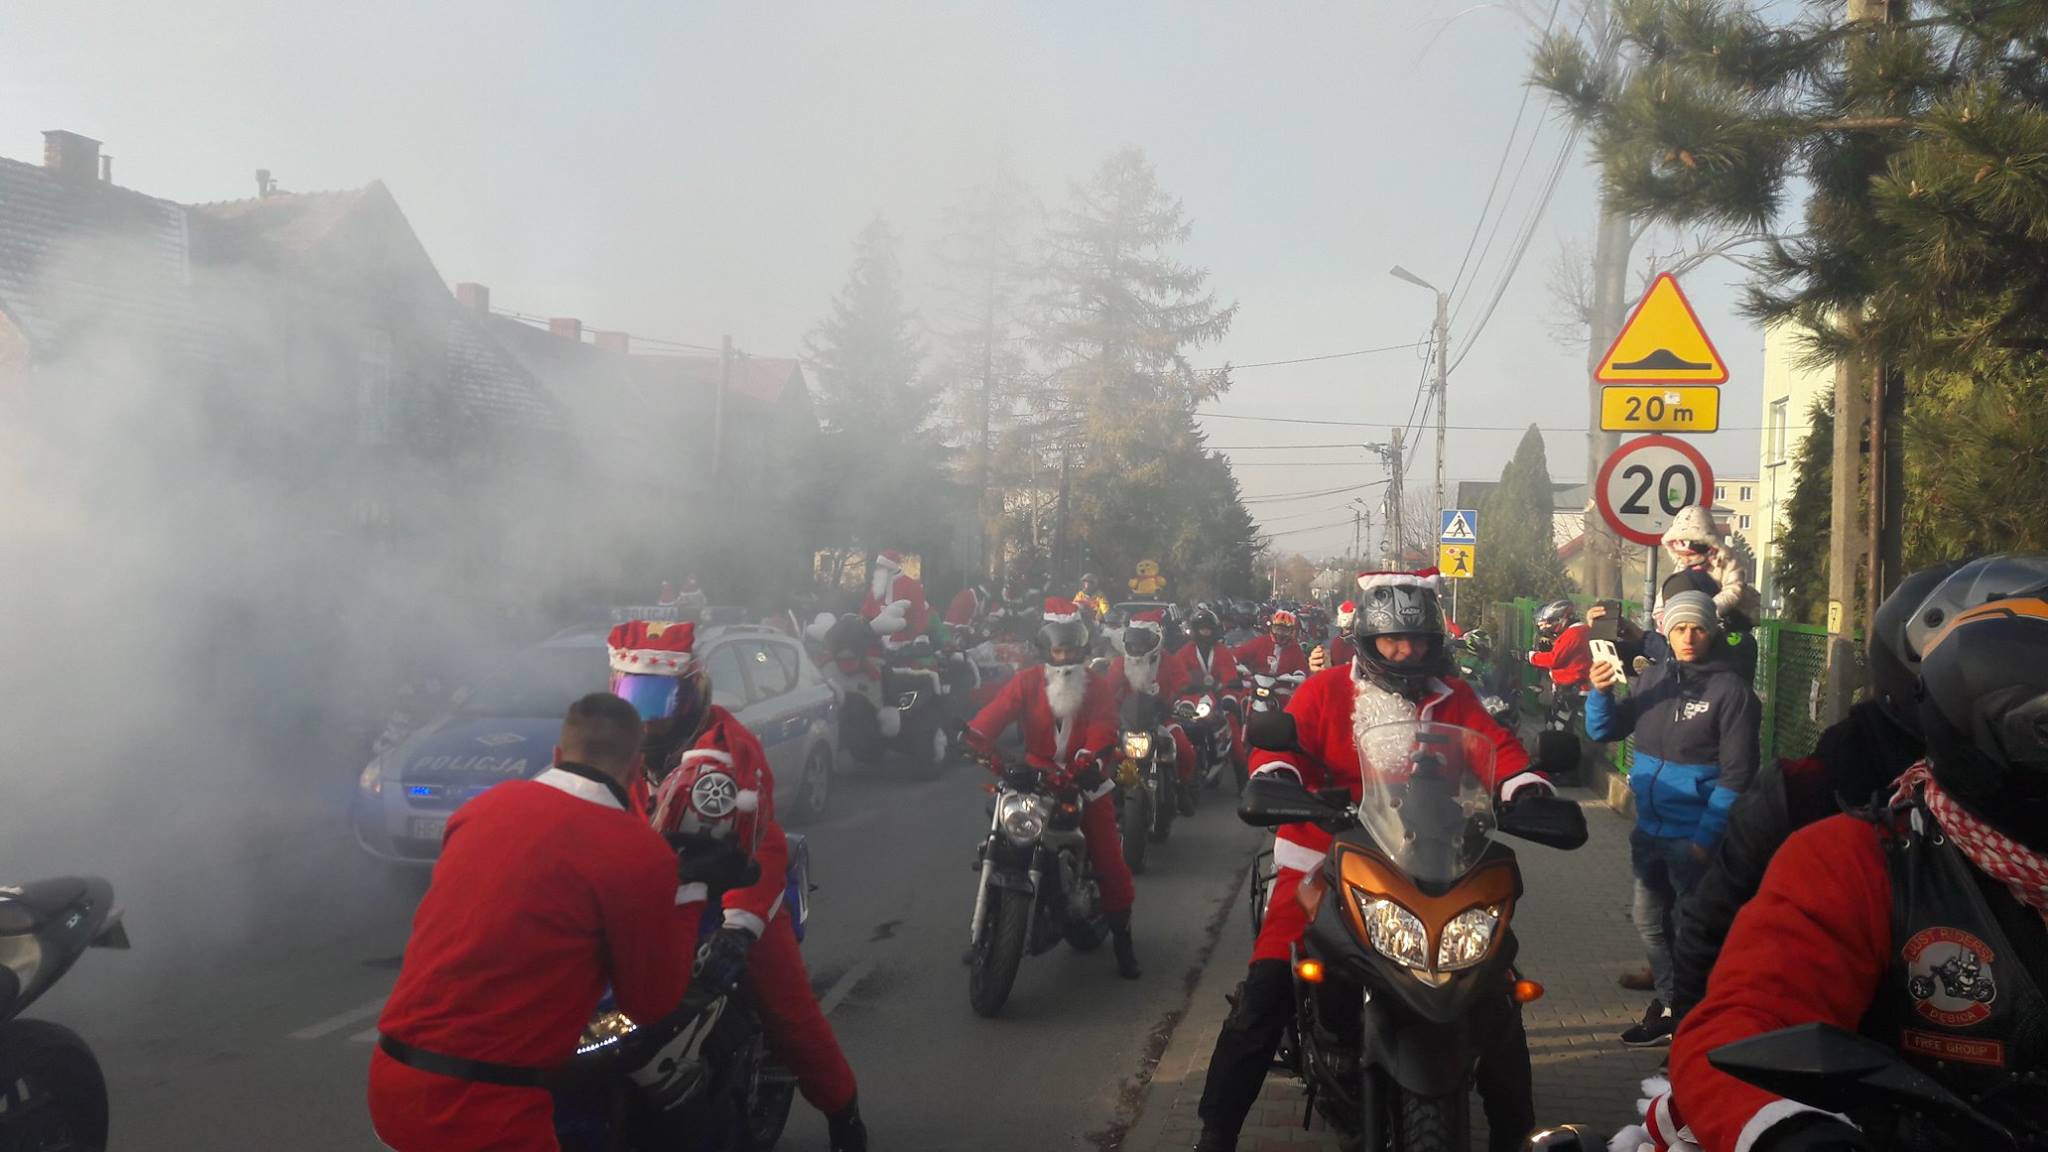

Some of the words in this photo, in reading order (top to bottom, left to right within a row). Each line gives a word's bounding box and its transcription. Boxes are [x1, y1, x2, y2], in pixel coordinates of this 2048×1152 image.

[1624, 396, 1664, 422] 20
[1673, 407, 1694, 422] m
[1619, 464, 1696, 517] 20
[415, 755, 527, 775] POLICJA
[1914, 1036, 1942, 1051] FREE
[1946, 1041, 1989, 1056] GROUP
